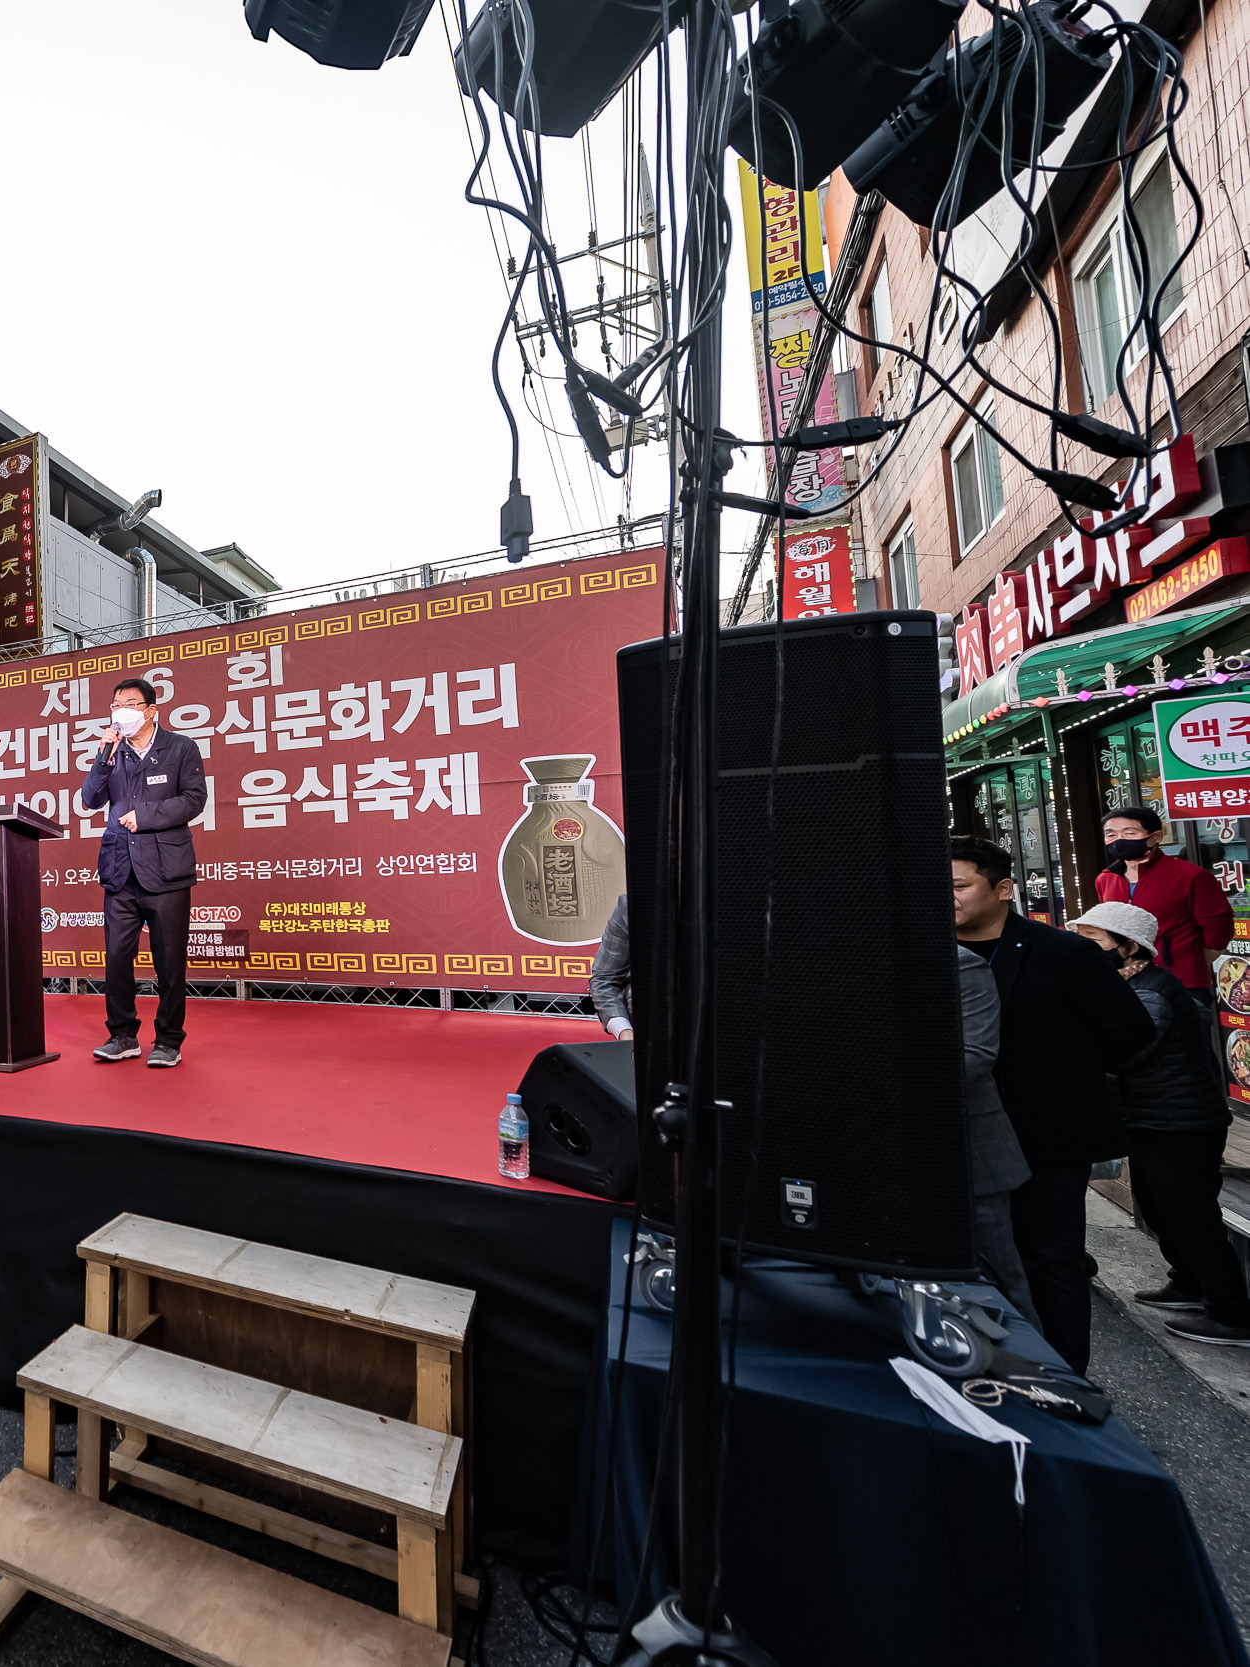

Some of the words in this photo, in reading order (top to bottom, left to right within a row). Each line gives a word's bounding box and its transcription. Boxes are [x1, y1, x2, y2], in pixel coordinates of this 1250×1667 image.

[773, 265, 801, 283] 2F
[1130, 548, 1220, 624] 02)462-5450
[40, 677, 91, 718] 제
[143, 667, 176, 705] 6
[226, 645, 285, 693] 회
[237, 751, 482, 831] 음식축제
[1174, 788, 1250, 809] 해월양
[376, 852, 478, 877] 상인연합회
[264, 901, 367, 917] (주)대진미래통상
